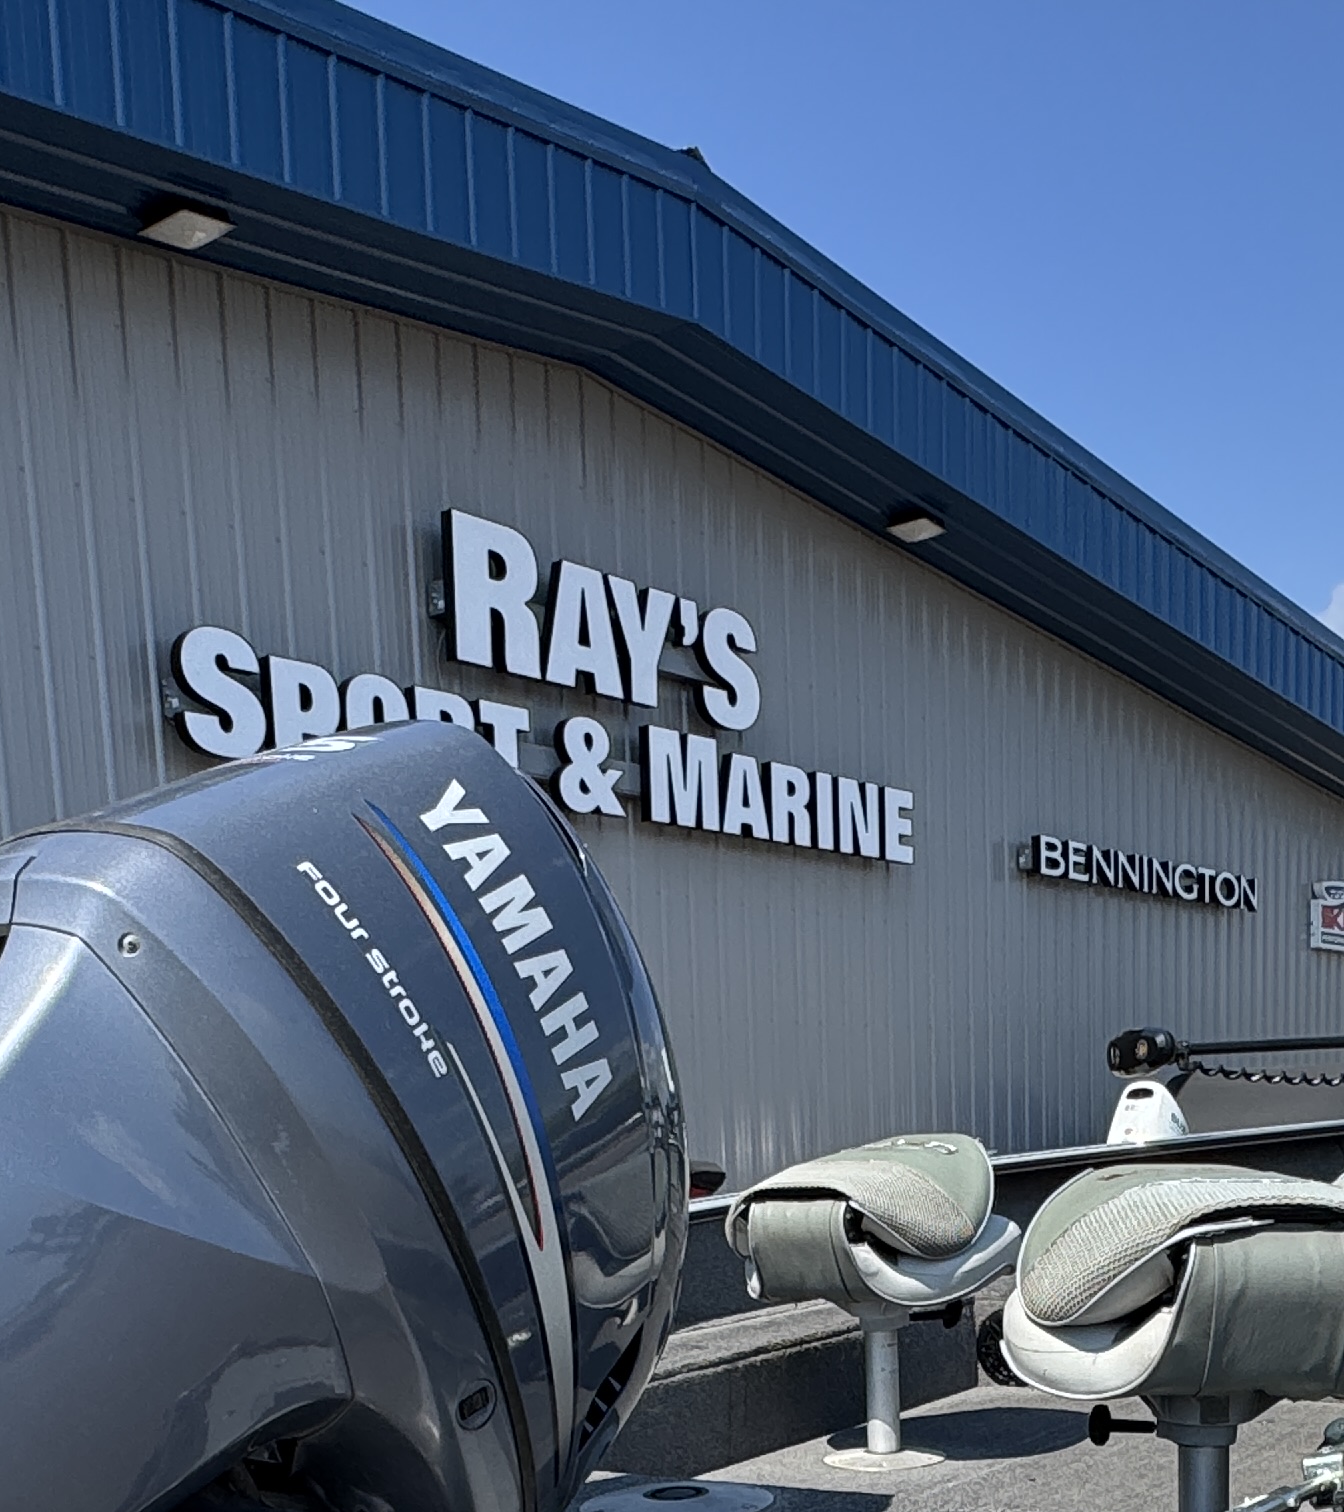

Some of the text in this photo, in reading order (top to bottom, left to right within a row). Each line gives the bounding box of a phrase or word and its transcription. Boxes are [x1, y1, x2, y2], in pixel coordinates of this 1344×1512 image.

[449, 508, 762, 732] RAY'S
[558, 715, 627, 818] &
[644, 723, 915, 865] MARINE
[1038, 833, 1258, 911] BENNINGTON
[418, 777, 615, 1123] YAMAHA
